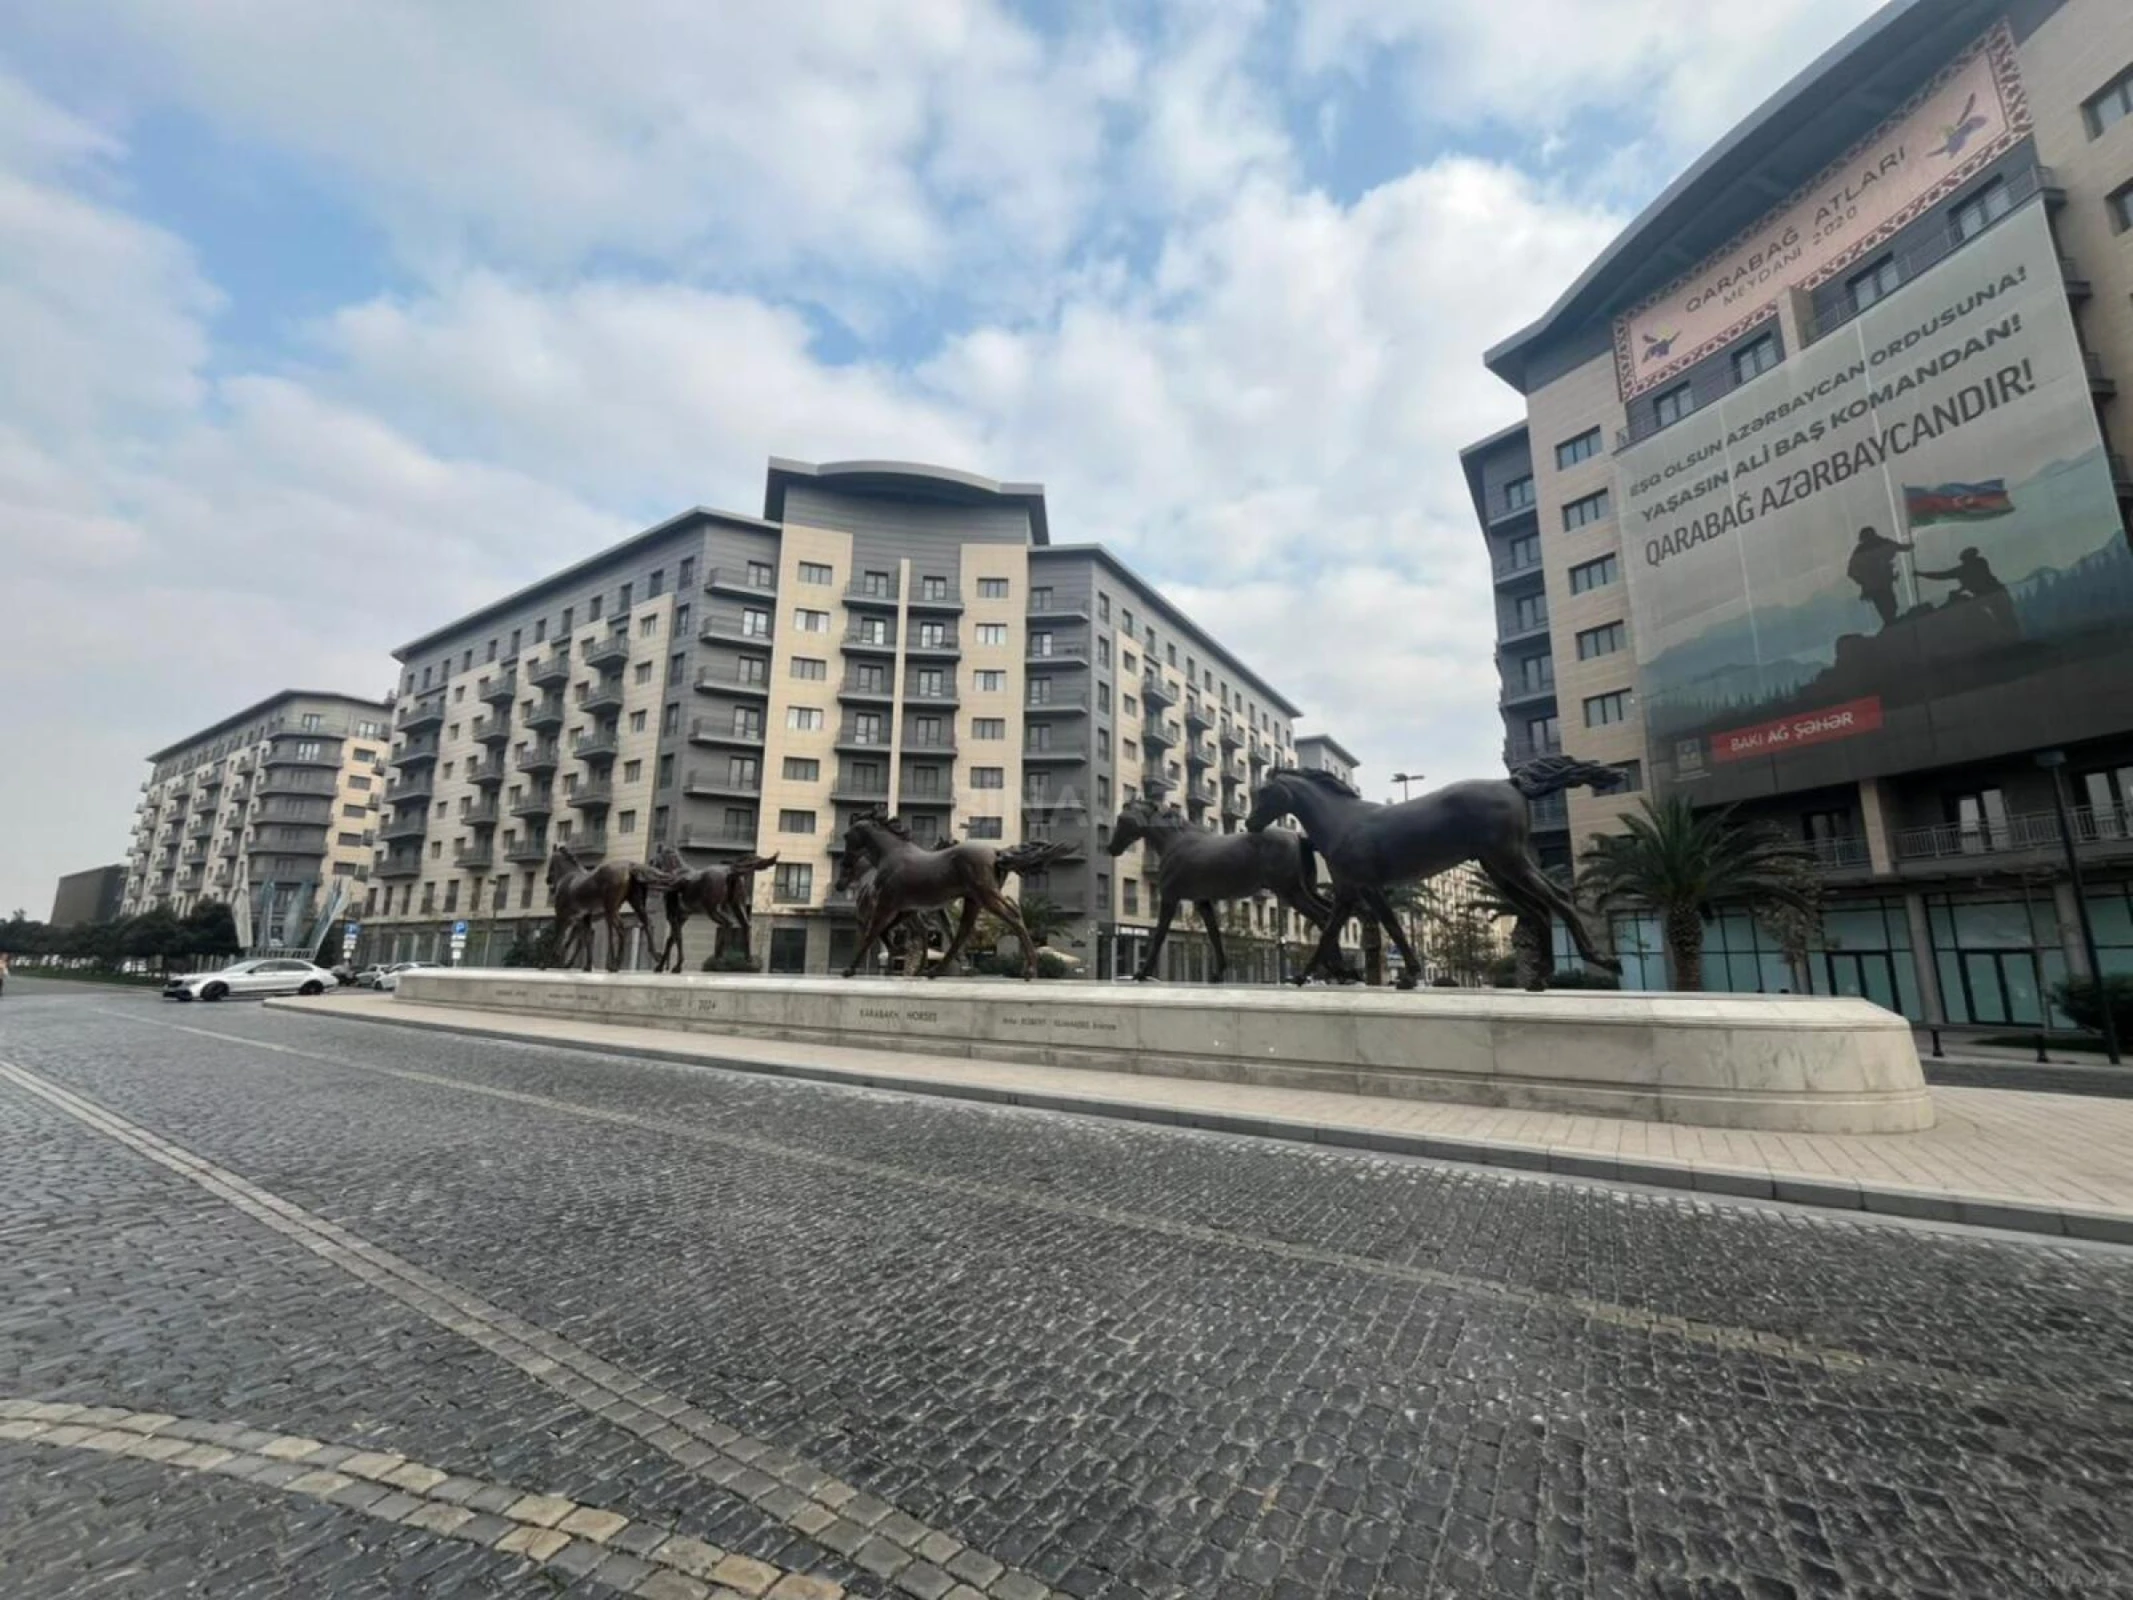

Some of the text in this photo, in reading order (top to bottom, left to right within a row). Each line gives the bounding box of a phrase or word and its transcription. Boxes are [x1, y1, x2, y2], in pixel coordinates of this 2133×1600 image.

[1685, 146, 1906, 313] QARABAĞ ATLARI
[1722, 205, 1858, 307] MEYDANI 2020
[1641, 313, 2023, 523] YAŞASIN ALİ BAŞ KOMANDAN!
[1645, 357, 2037, 568] QARABAĞ AZƏRBAYCANDIR!
[1663, 439, 1723, 479] OLSUN
[1726, 360, 1866, 446] AZƏRBAYCAN
[1869, 265, 2028, 367] ORDUSUNA!
[1730, 711, 1854, 752] BAKI AĞ ŞƏHƏR
